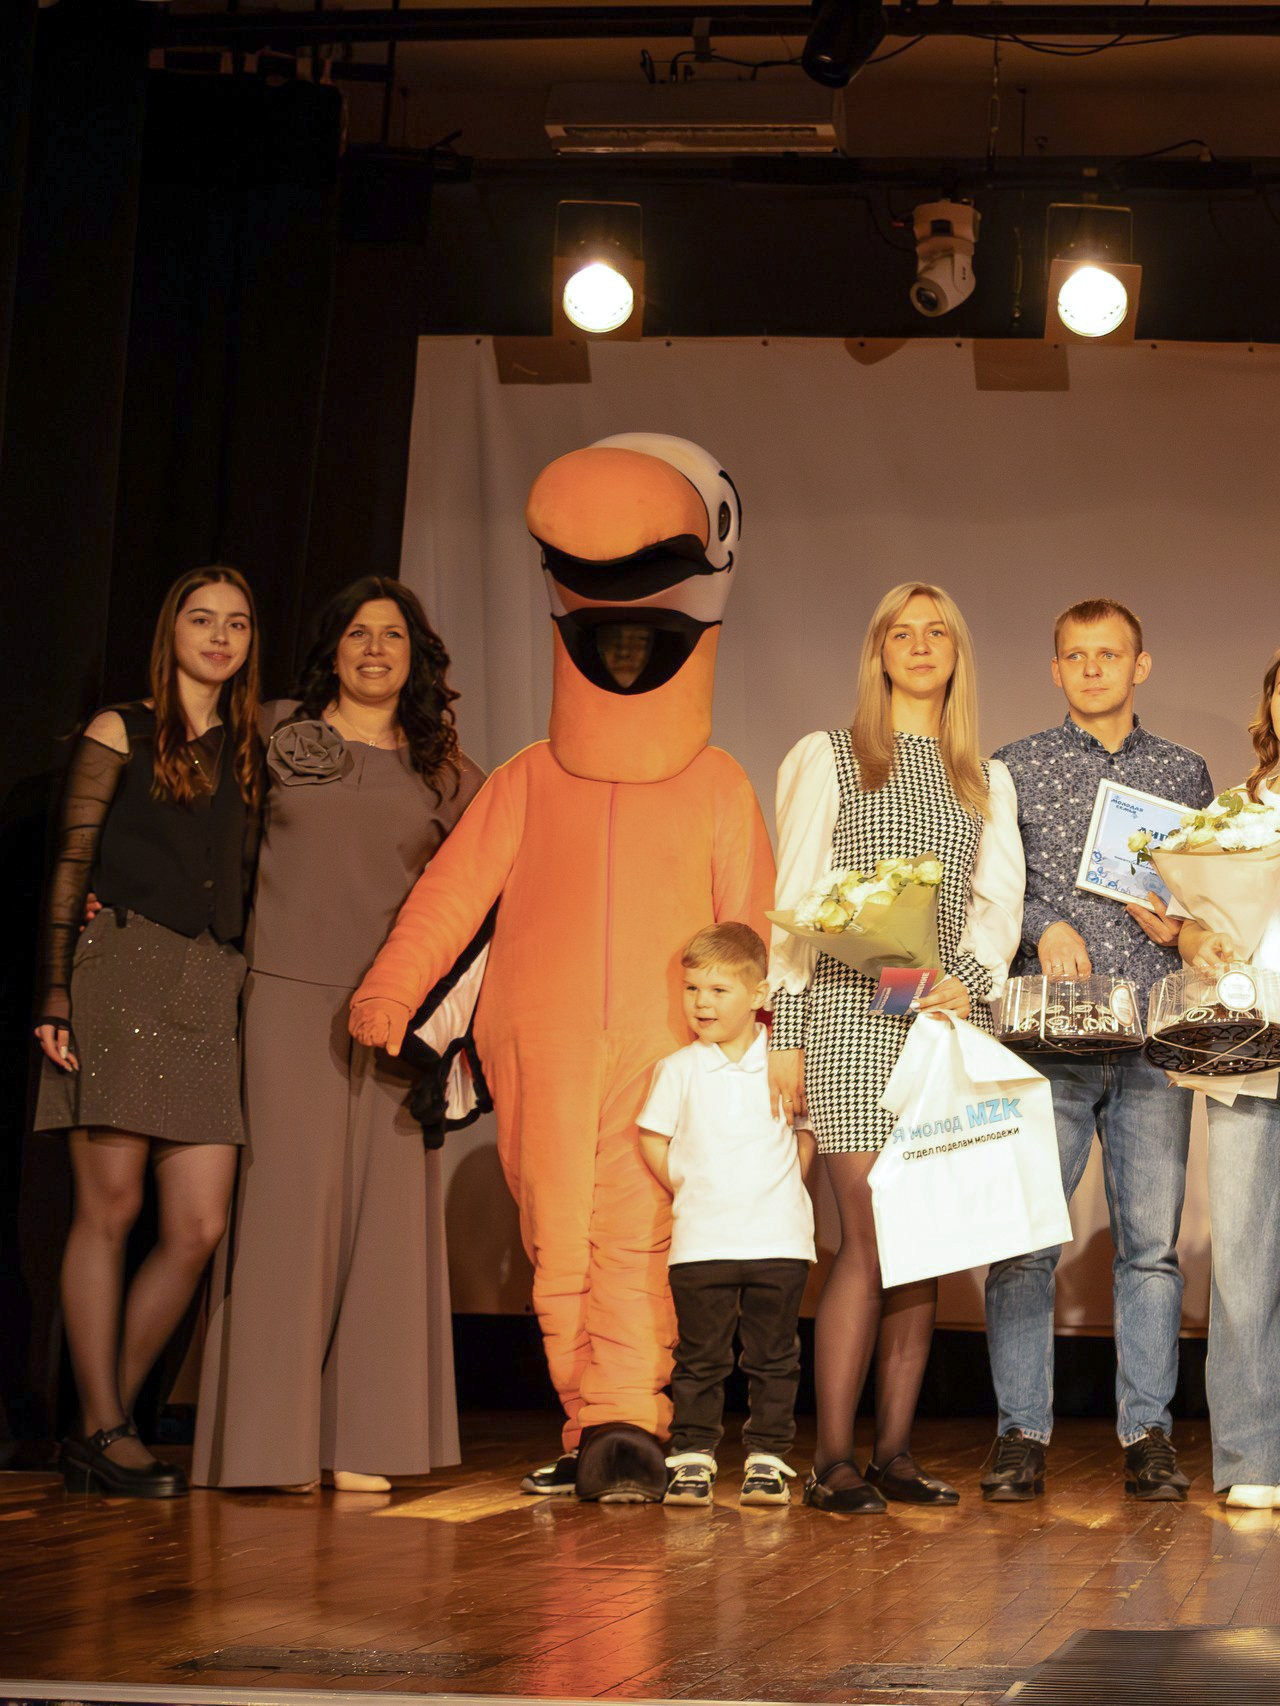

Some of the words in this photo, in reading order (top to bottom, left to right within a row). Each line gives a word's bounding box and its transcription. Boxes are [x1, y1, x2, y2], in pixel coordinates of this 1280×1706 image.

[892, 1126, 906, 1145] Я
[965, 1097, 1023, 1129] MZK
[902, 1147, 934, 1161] Отдел
[974, 1127, 1021, 1144] молодежи
